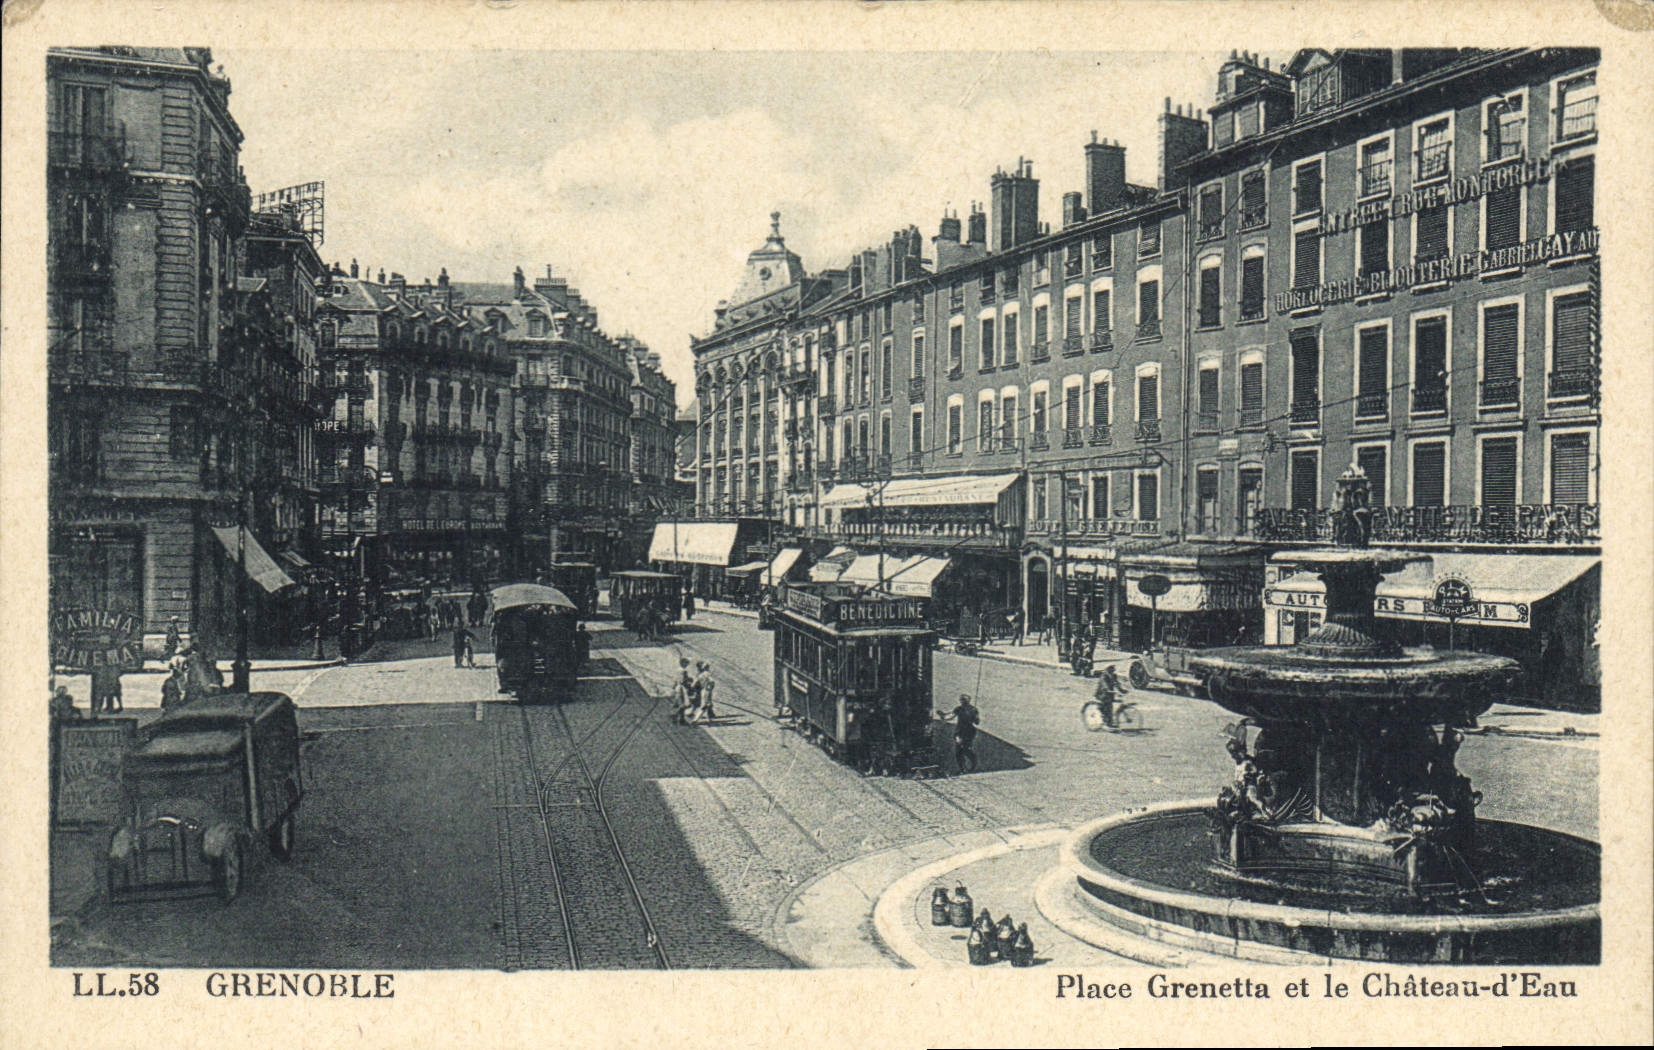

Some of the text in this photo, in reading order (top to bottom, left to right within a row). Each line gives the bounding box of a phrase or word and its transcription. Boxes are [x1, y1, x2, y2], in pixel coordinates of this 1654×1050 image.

[1401, 186, 1437, 215] RUE
[1370, 253, 1470, 293] BIJOUTERIE
[1538, 231, 1576, 260] GAY
[55, 611, 133, 634] FAMILIA
[839, 602, 924, 620] BENEDICTINE
